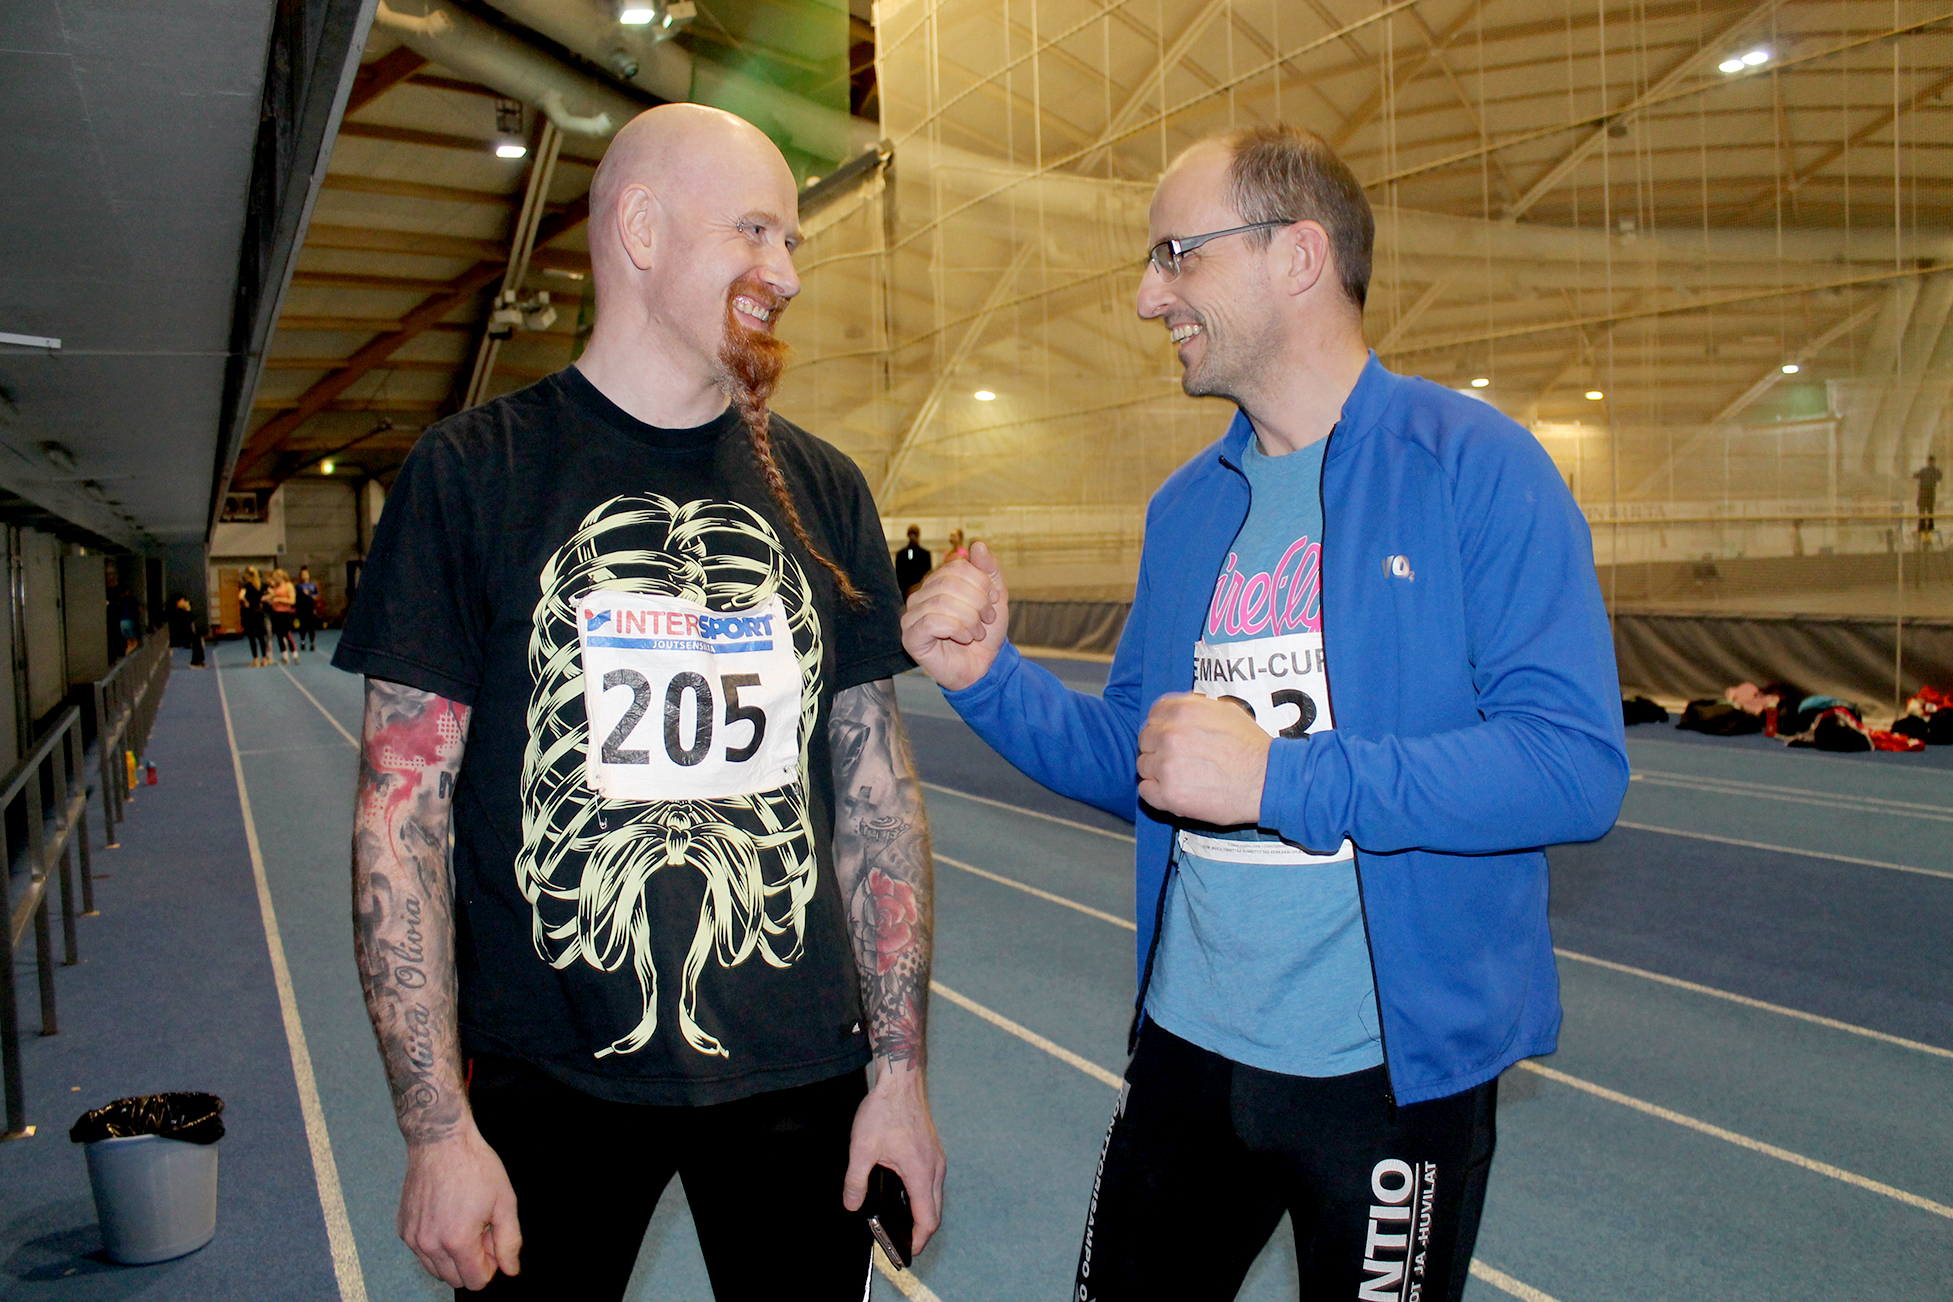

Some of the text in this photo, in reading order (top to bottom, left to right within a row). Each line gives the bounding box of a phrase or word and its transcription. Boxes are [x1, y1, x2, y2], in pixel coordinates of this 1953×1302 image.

[616, 610, 773, 639] INTERSPORT
[601, 668, 766, 766] 205
[390, 893, 427, 989] Olivia
[1413, 1251, 1427, 1276] JA
